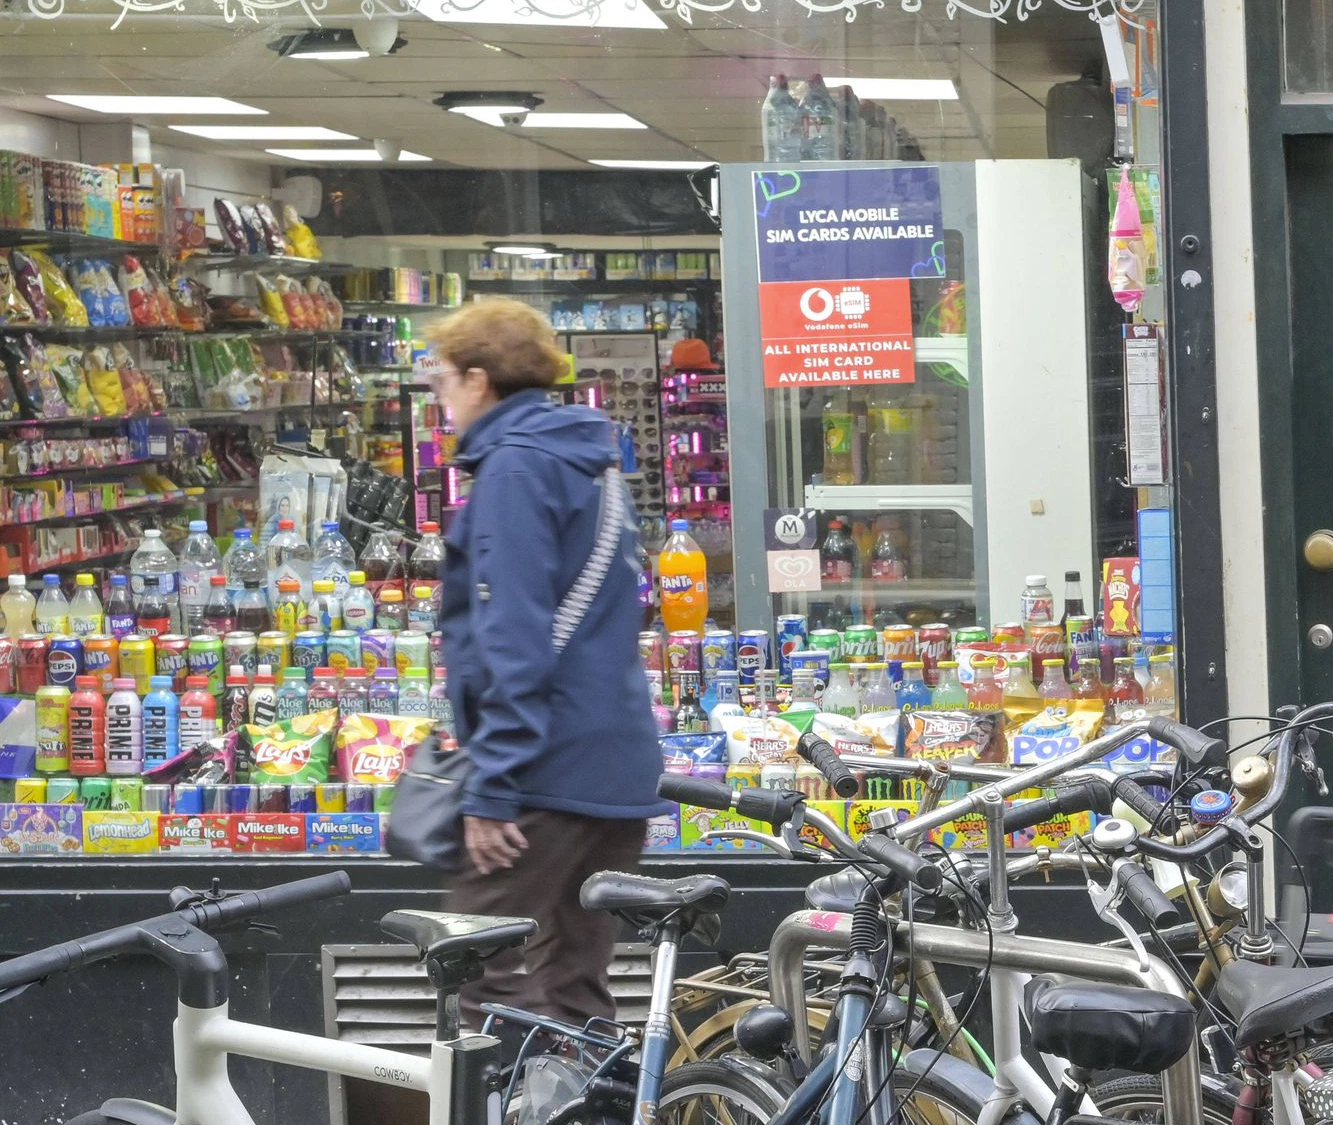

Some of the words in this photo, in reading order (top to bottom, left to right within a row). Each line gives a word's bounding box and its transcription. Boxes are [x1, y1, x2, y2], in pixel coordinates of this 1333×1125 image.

[799, 210, 839, 224] LYCA
[841, 208, 899, 223] MOBILE
[766, 229, 795, 243] SIM
[797, 227, 850, 241] CARDS
[853, 225, 934, 240] AVAILABLE
[804, 322, 845, 331] Vodafone
[765, 344, 791, 355] ALL
[796, 340, 911, 354] INTERNATIONAL
[804, 356, 829, 367] SIM
[834, 355, 874, 366] CARD
[779, 370, 858, 382] AVAILABLE
[863, 368, 901, 379] HERE
[783, 579, 807, 588] OLA
[277, 698, 302, 709] Aloe
[307, 698, 332, 708] Aloe
[339, 698, 363, 708] Aloe
[369, 698, 393, 708] Aloe
[71, 706, 93, 761] PRIME
[108, 704, 131, 760] PRIME
[145, 705, 167, 761] PRIME
[180, 705, 203, 750] PRIM
[238, 822, 273, 834] Mike
[278, 823, 299, 834] Ike
[312, 822, 348, 834] Mike
[352, 823, 373, 834] Ike
[954, 820, 988, 831] PATCH
[1038, 822, 1071, 834] PATCH
[164, 826, 200, 837] Mike
[204, 826, 225, 838] Ike
[374, 1066, 412, 1083] COWBOY.
